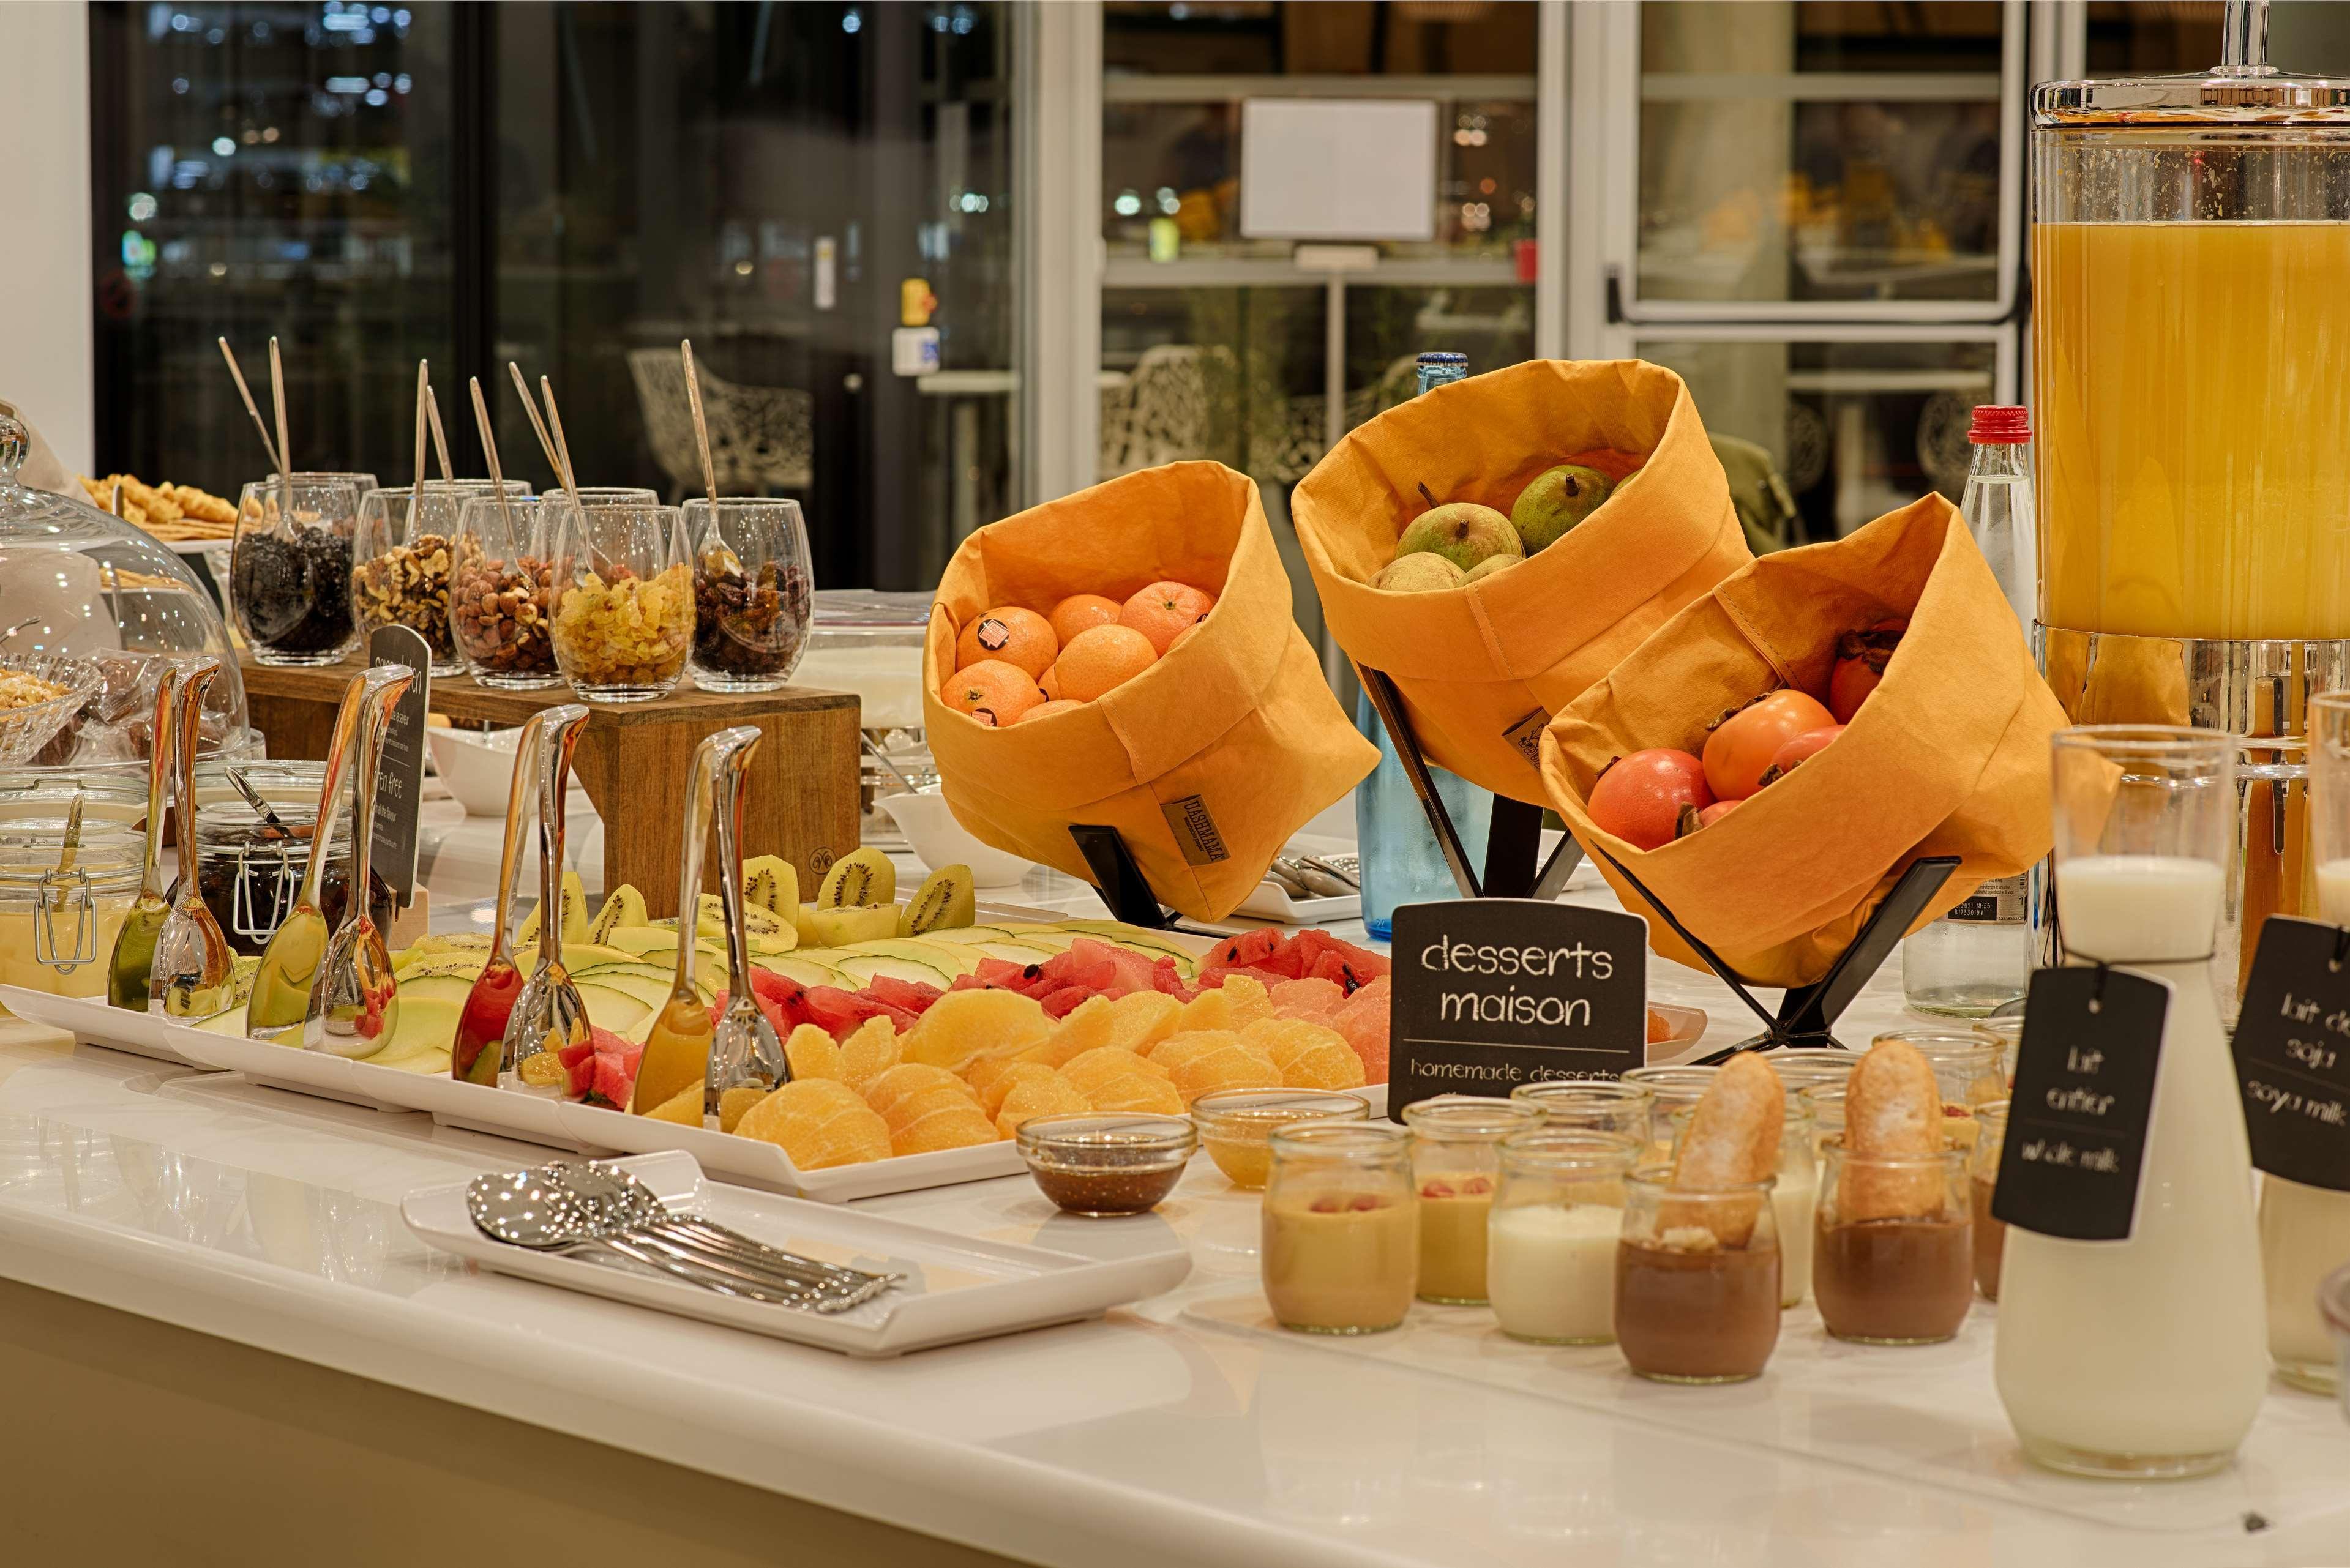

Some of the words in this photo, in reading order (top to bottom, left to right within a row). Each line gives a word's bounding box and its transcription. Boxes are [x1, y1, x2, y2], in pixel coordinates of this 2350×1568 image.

[388, 771, 402, 799] free
[1421, 934, 1613, 979] desserts
[1440, 985, 1590, 1026] maison
[1410, 1058, 1522, 1081] homemade
[1530, 1065, 1619, 1082] desserts
